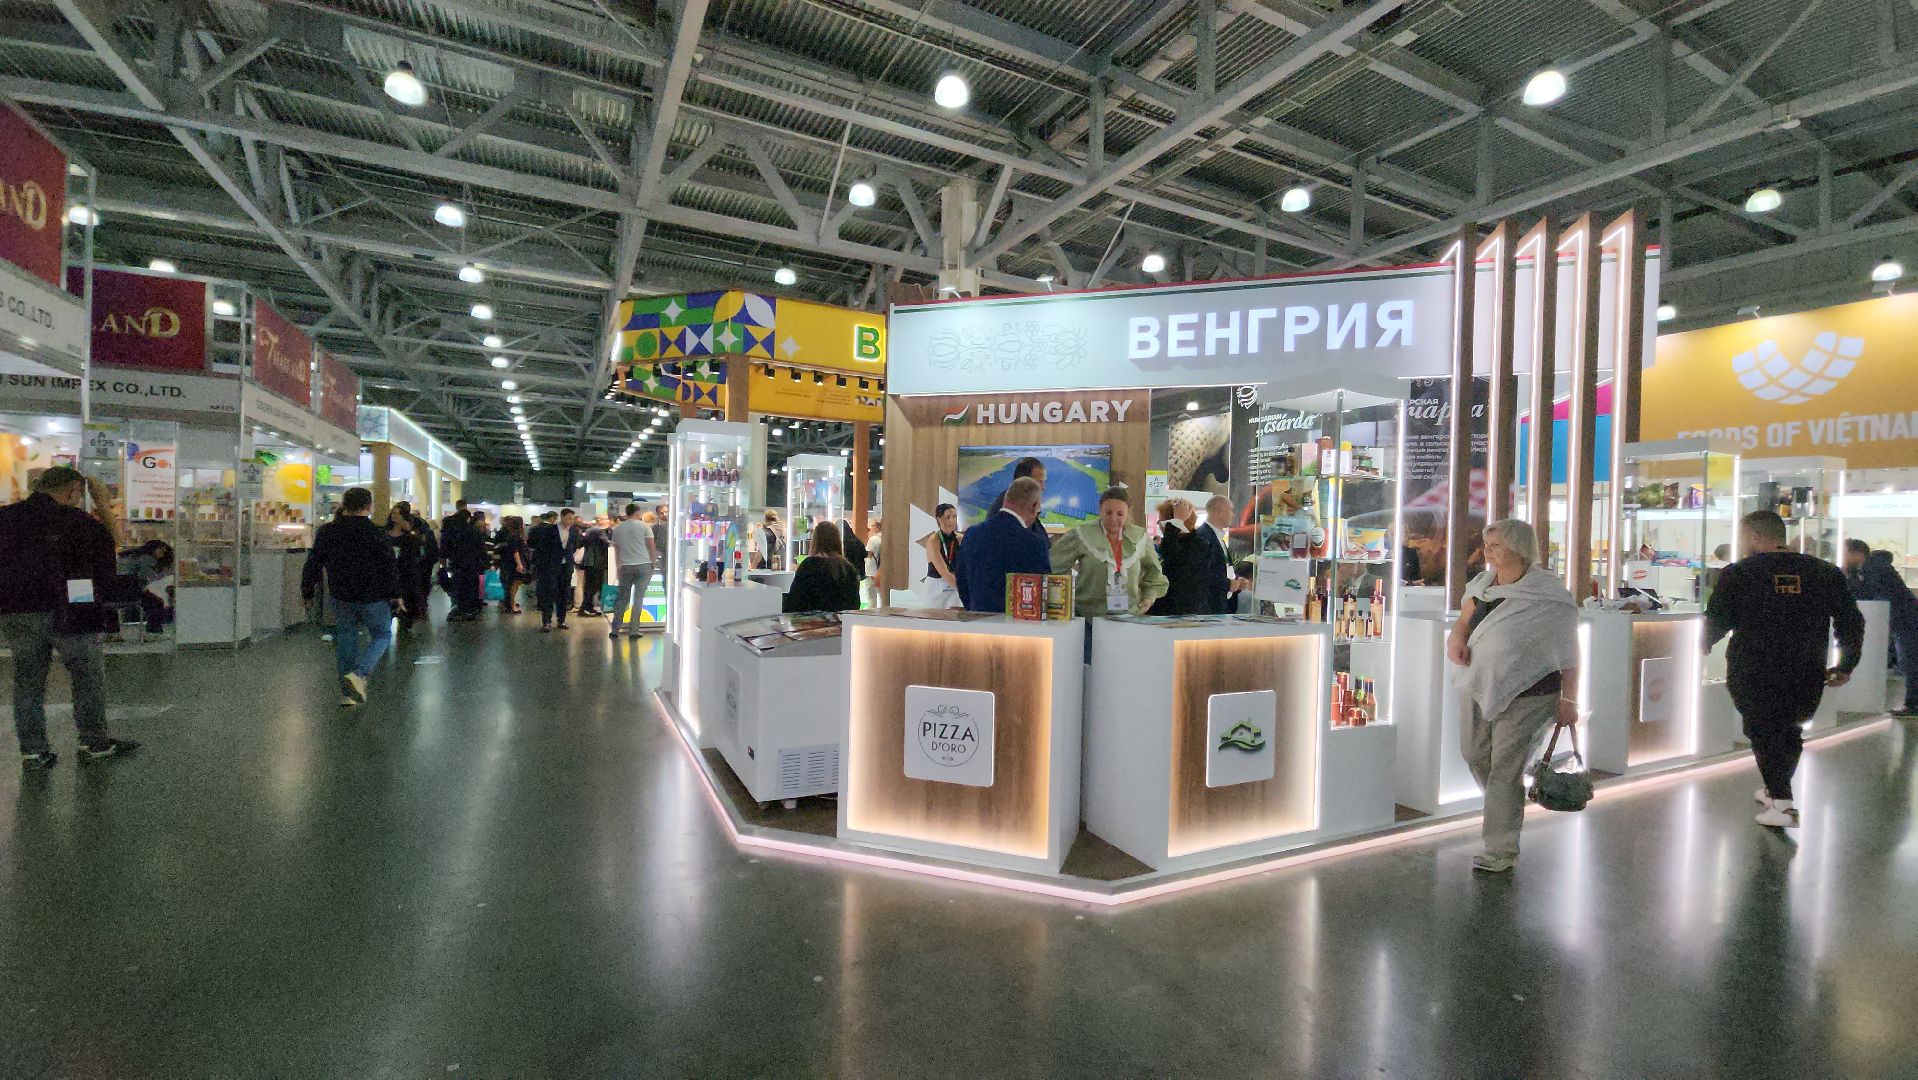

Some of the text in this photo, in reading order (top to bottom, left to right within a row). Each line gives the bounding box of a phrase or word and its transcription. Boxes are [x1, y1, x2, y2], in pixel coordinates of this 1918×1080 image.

[92, 307, 181, 338] AND
[1128, 299, 1415, 360] ВЕНГРИЯ
[976, 399, 1132, 425] HUNGARY
[1766, 421, 1801, 448] OF
[922, 721, 976, 743] PIZZA
[931, 741, 967, 754] D'ORO
